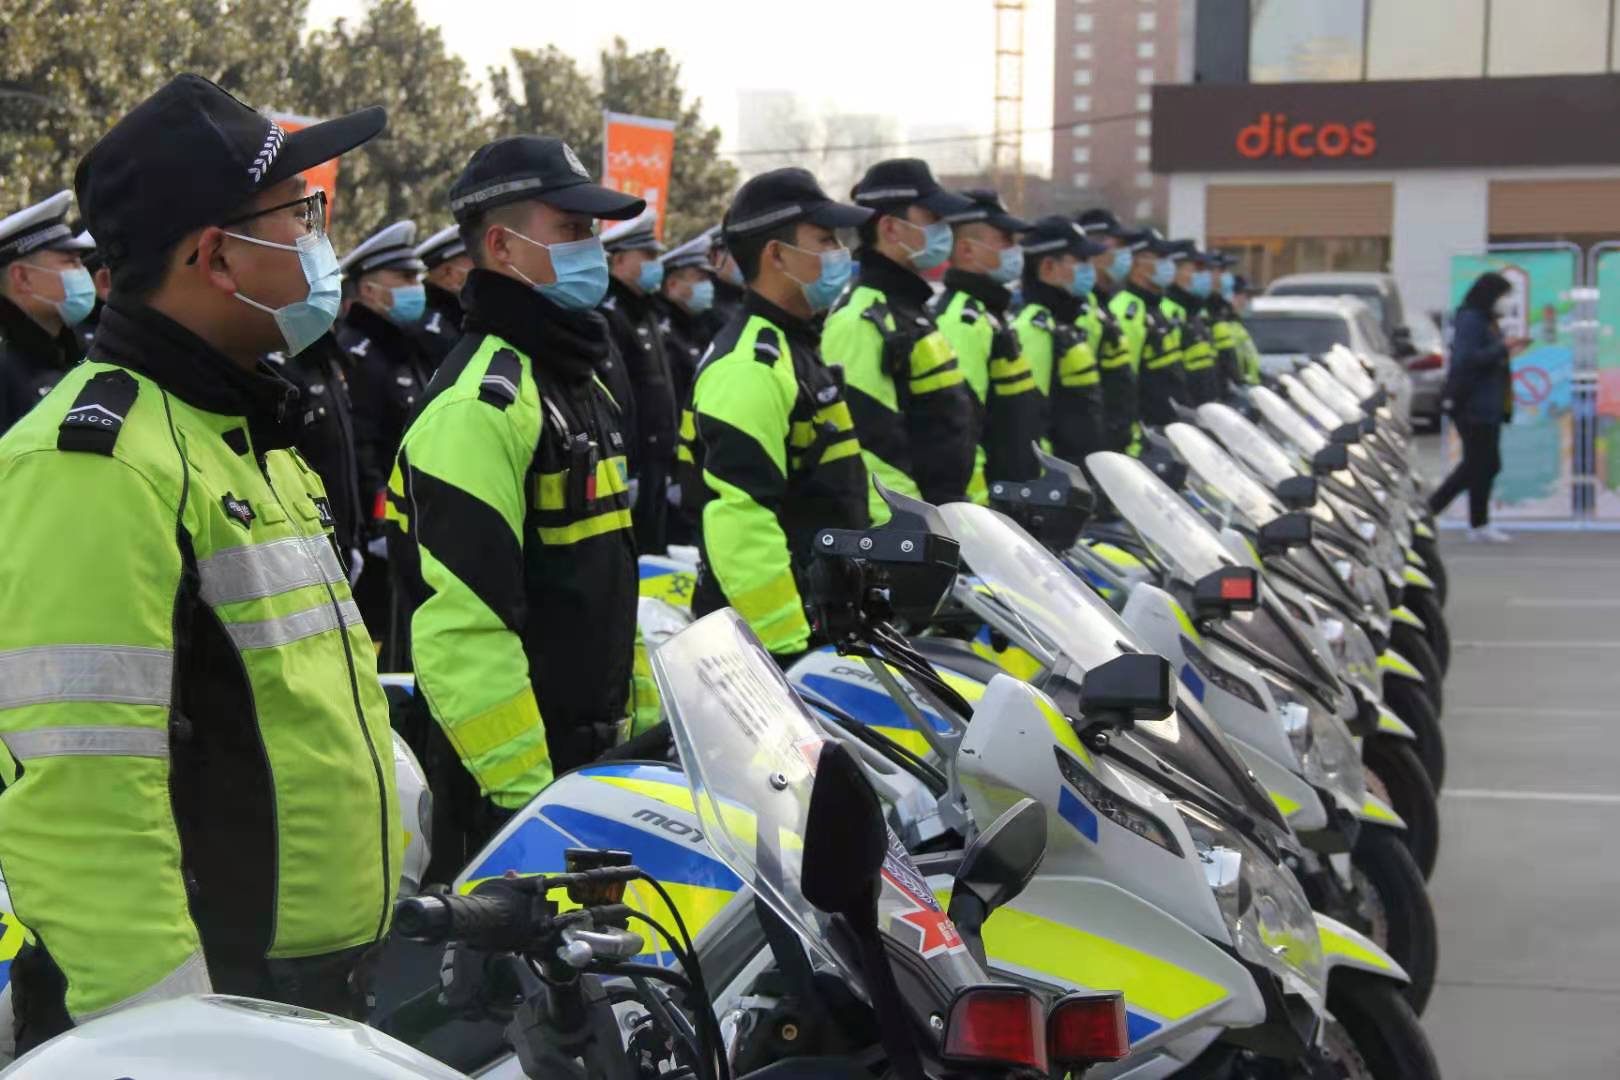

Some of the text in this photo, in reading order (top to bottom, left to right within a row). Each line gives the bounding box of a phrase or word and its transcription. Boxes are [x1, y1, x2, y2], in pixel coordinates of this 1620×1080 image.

[1236, 112, 1377, 159] dicos
[66, 413, 113, 426] PICC
[632, 809, 705, 843] MOT
